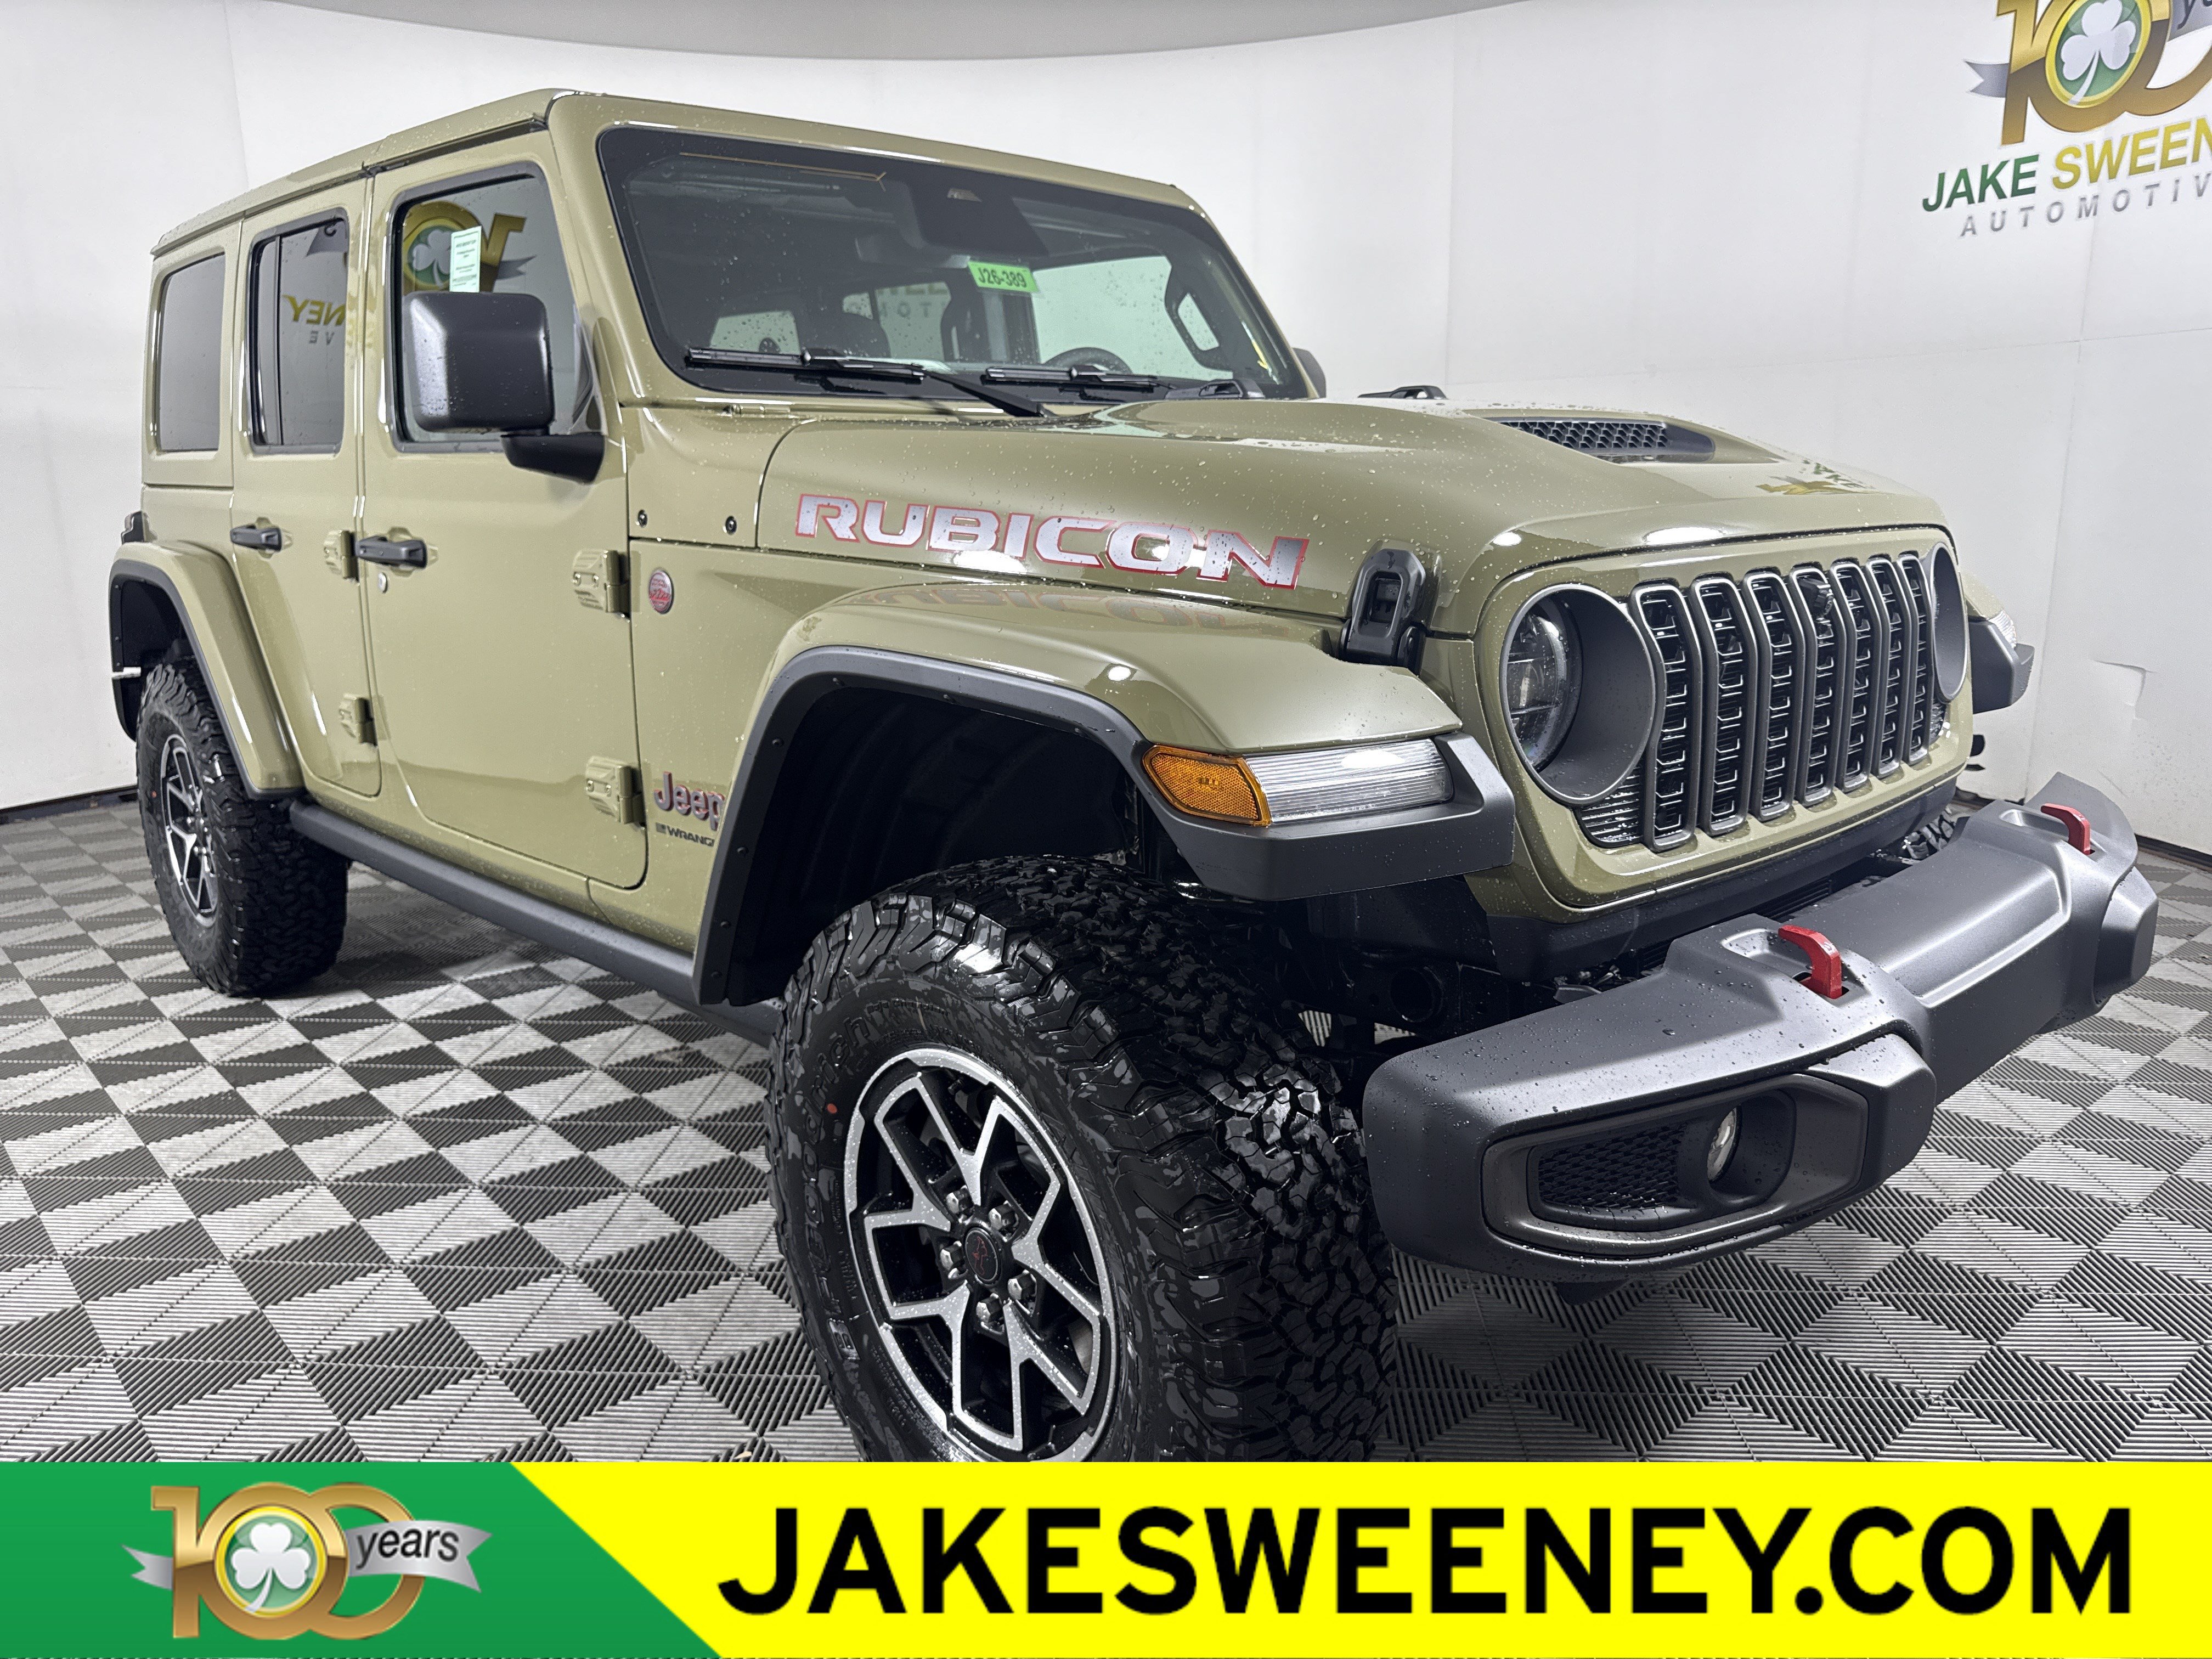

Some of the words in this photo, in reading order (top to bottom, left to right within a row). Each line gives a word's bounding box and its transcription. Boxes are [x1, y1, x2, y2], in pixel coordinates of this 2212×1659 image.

[1922, 154, 2039, 212] JAKE
[1960, 172, 2212, 236] AUTOMOTIV
[978, 267, 1026, 288] J26-389
[795, 493, 1310, 590] RUBICON
[653, 770, 725, 831] Jeep
